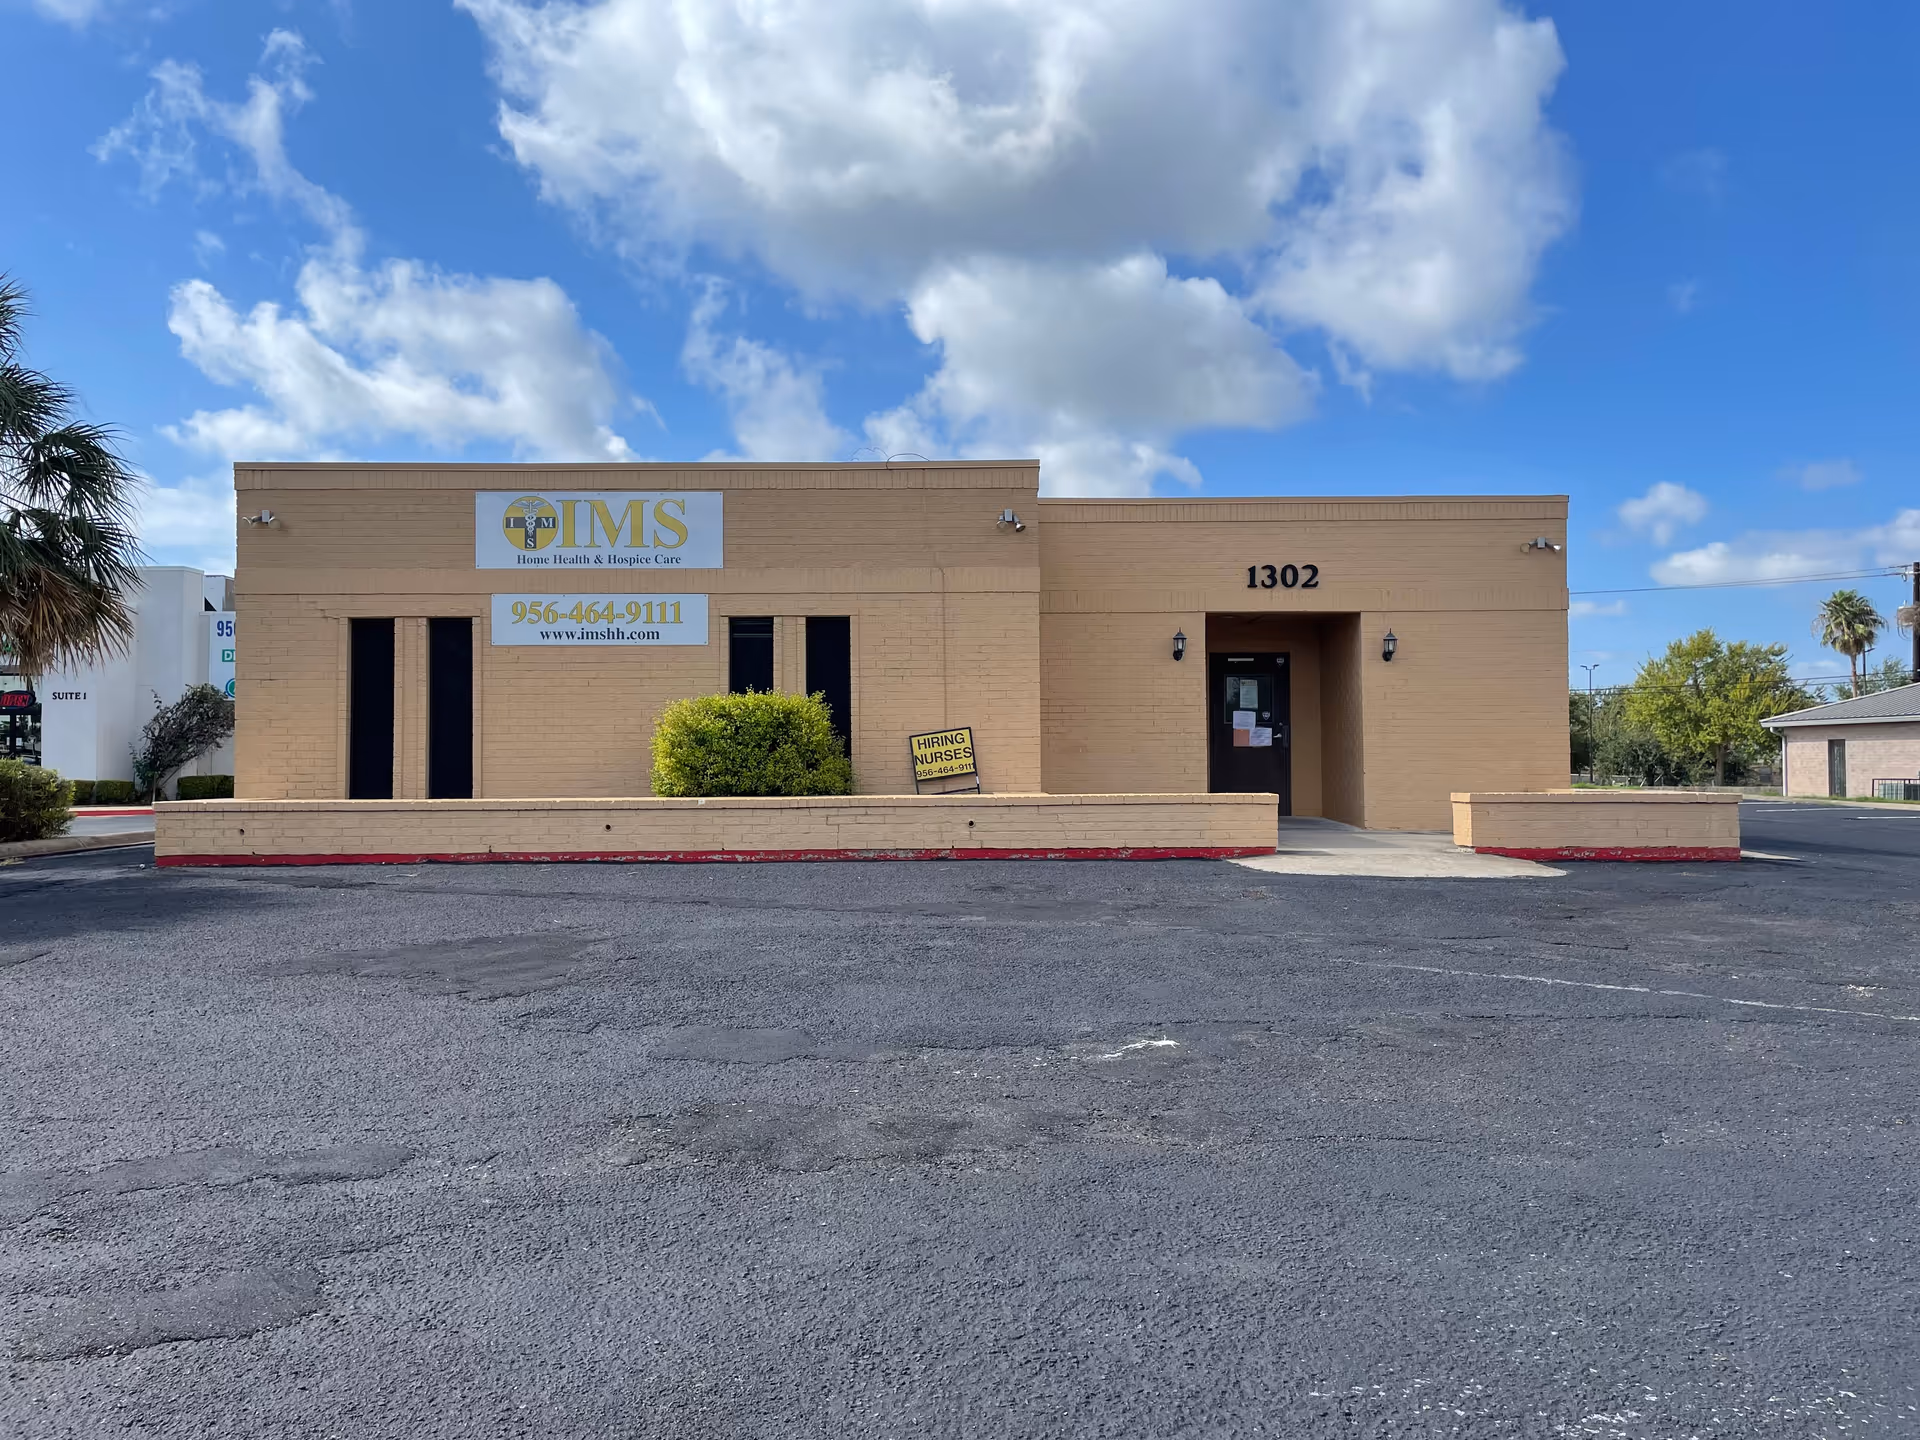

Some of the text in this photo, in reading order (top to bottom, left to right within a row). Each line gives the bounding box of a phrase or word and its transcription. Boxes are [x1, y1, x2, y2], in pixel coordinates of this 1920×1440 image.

[541, 517, 554, 528] M
[556, 499, 688, 549] IMS
[526, 538, 535, 548] S
[517, 554, 681, 567] Home Health & Hospice Care
[1247, 564, 1319, 589] 1302
[511, 601, 683, 625] 956-464-9111
[540, 627, 660, 641] www.imshh.com
[52, 692, 81, 700] SUITE
[917, 732, 965, 750] HIRING
[914, 746, 973, 766] NURSES
